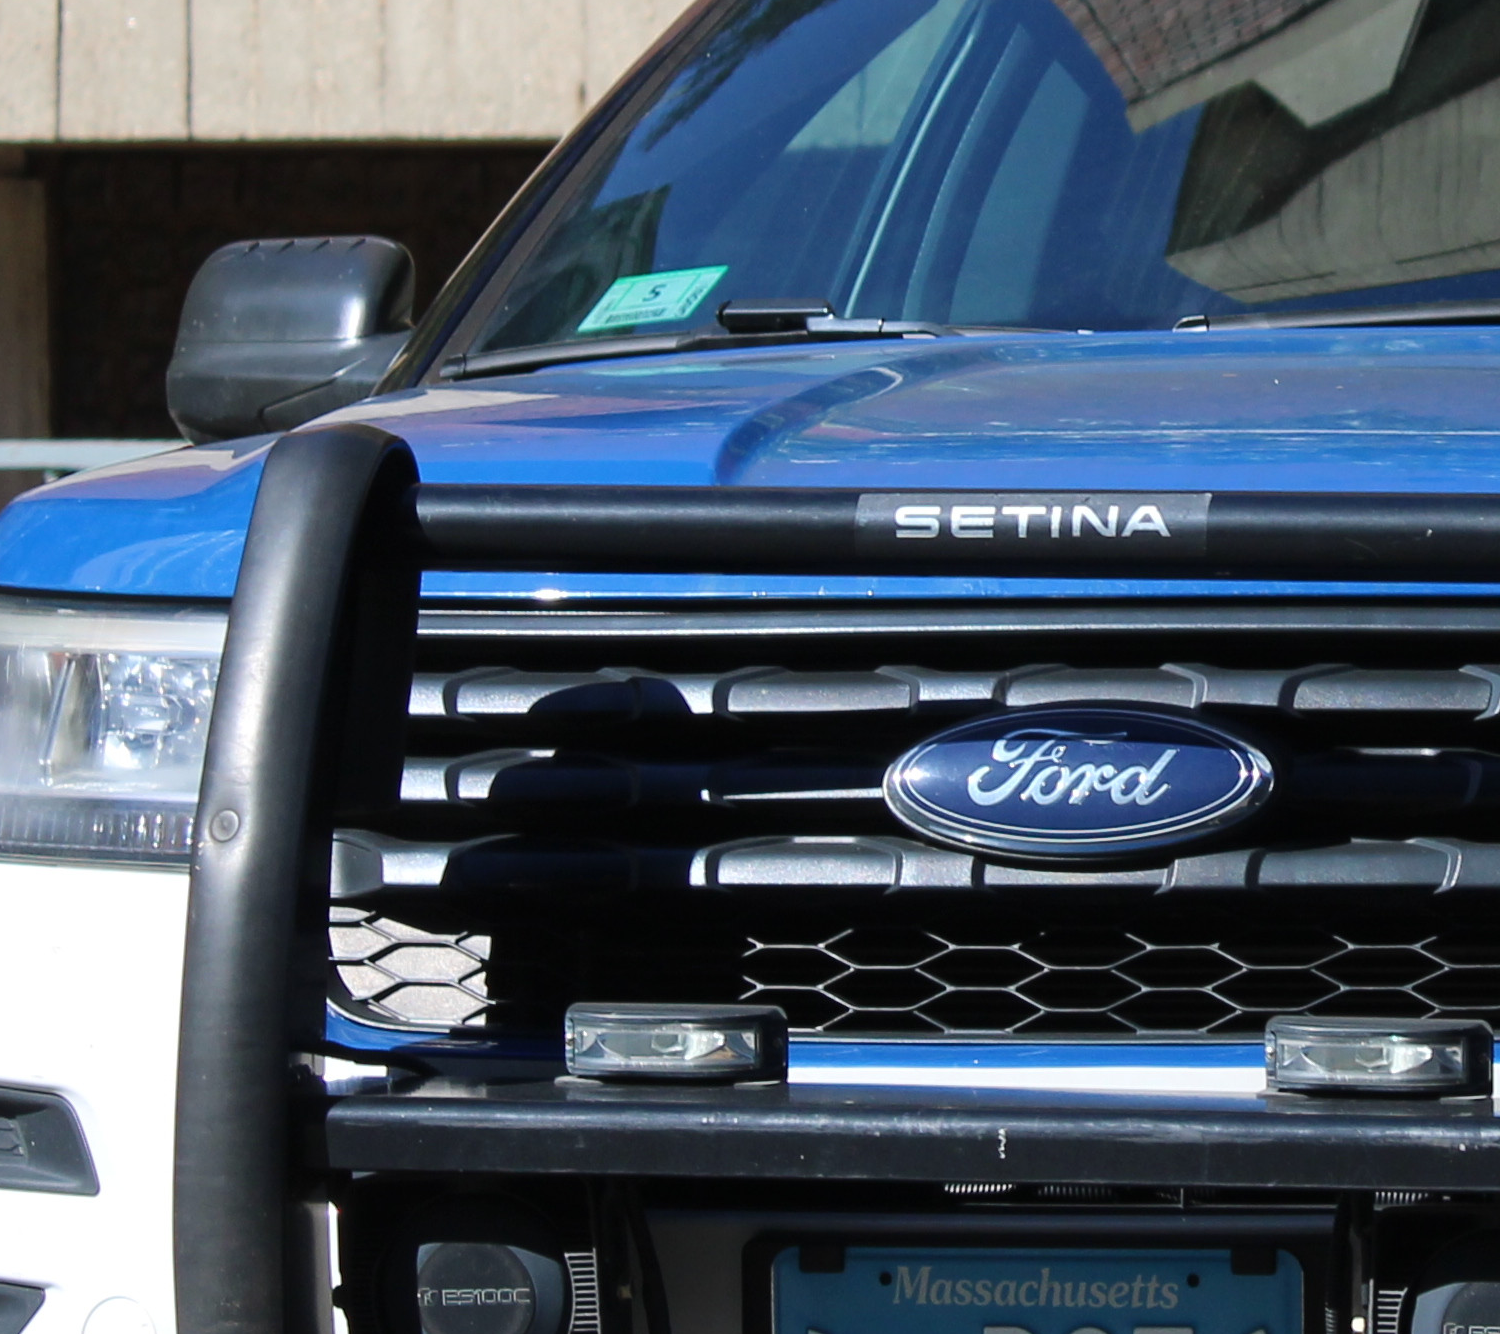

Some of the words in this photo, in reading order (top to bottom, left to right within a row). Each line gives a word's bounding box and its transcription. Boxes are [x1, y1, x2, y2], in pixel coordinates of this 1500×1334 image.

[895, 505, 1171, 539] SETINA
[967, 728, 1181, 807] Ford
[441, 1287, 531, 1306] ES100C
[892, 1265, 1180, 1309] Massachusetts
